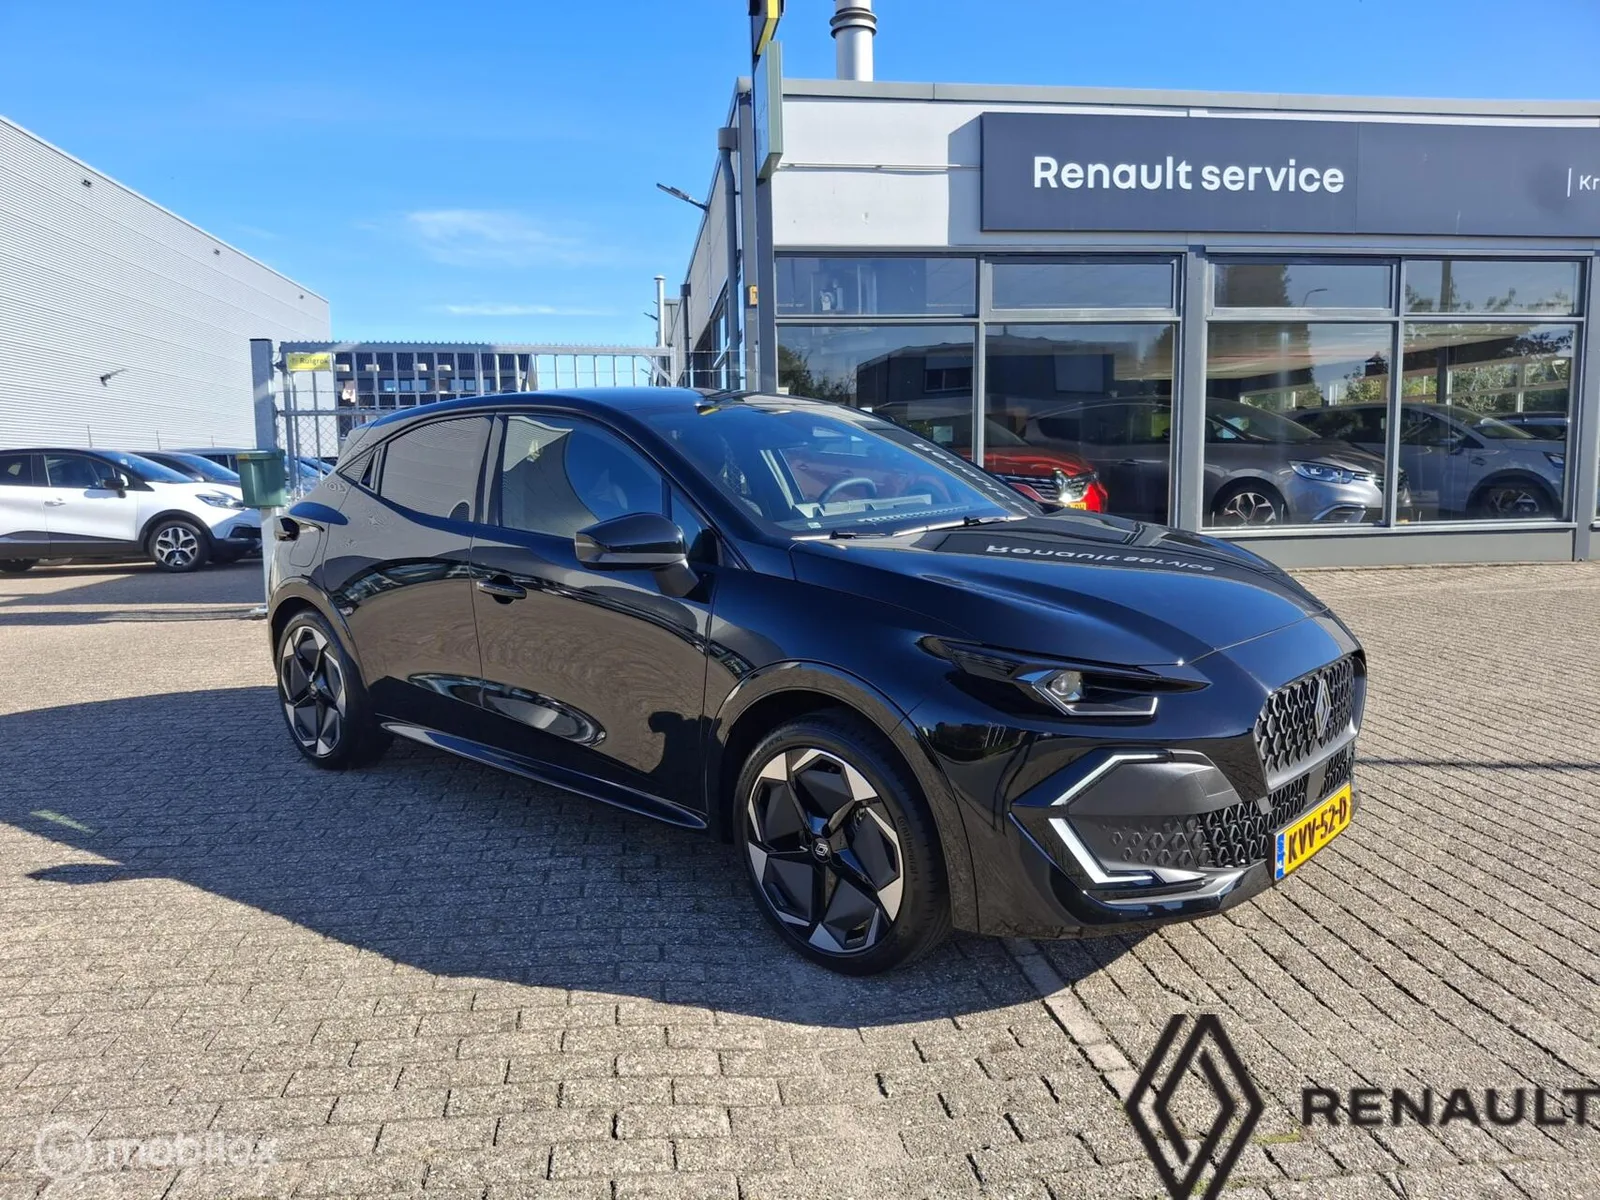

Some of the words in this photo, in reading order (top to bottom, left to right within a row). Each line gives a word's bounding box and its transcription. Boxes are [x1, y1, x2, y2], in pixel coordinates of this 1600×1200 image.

[1034, 156, 1193, 190] Renault
[1201, 159, 1345, 193] service
[1579, 174, 1600, 191] Kr
[1288, 796, 1347, 864] KVV-52-D
